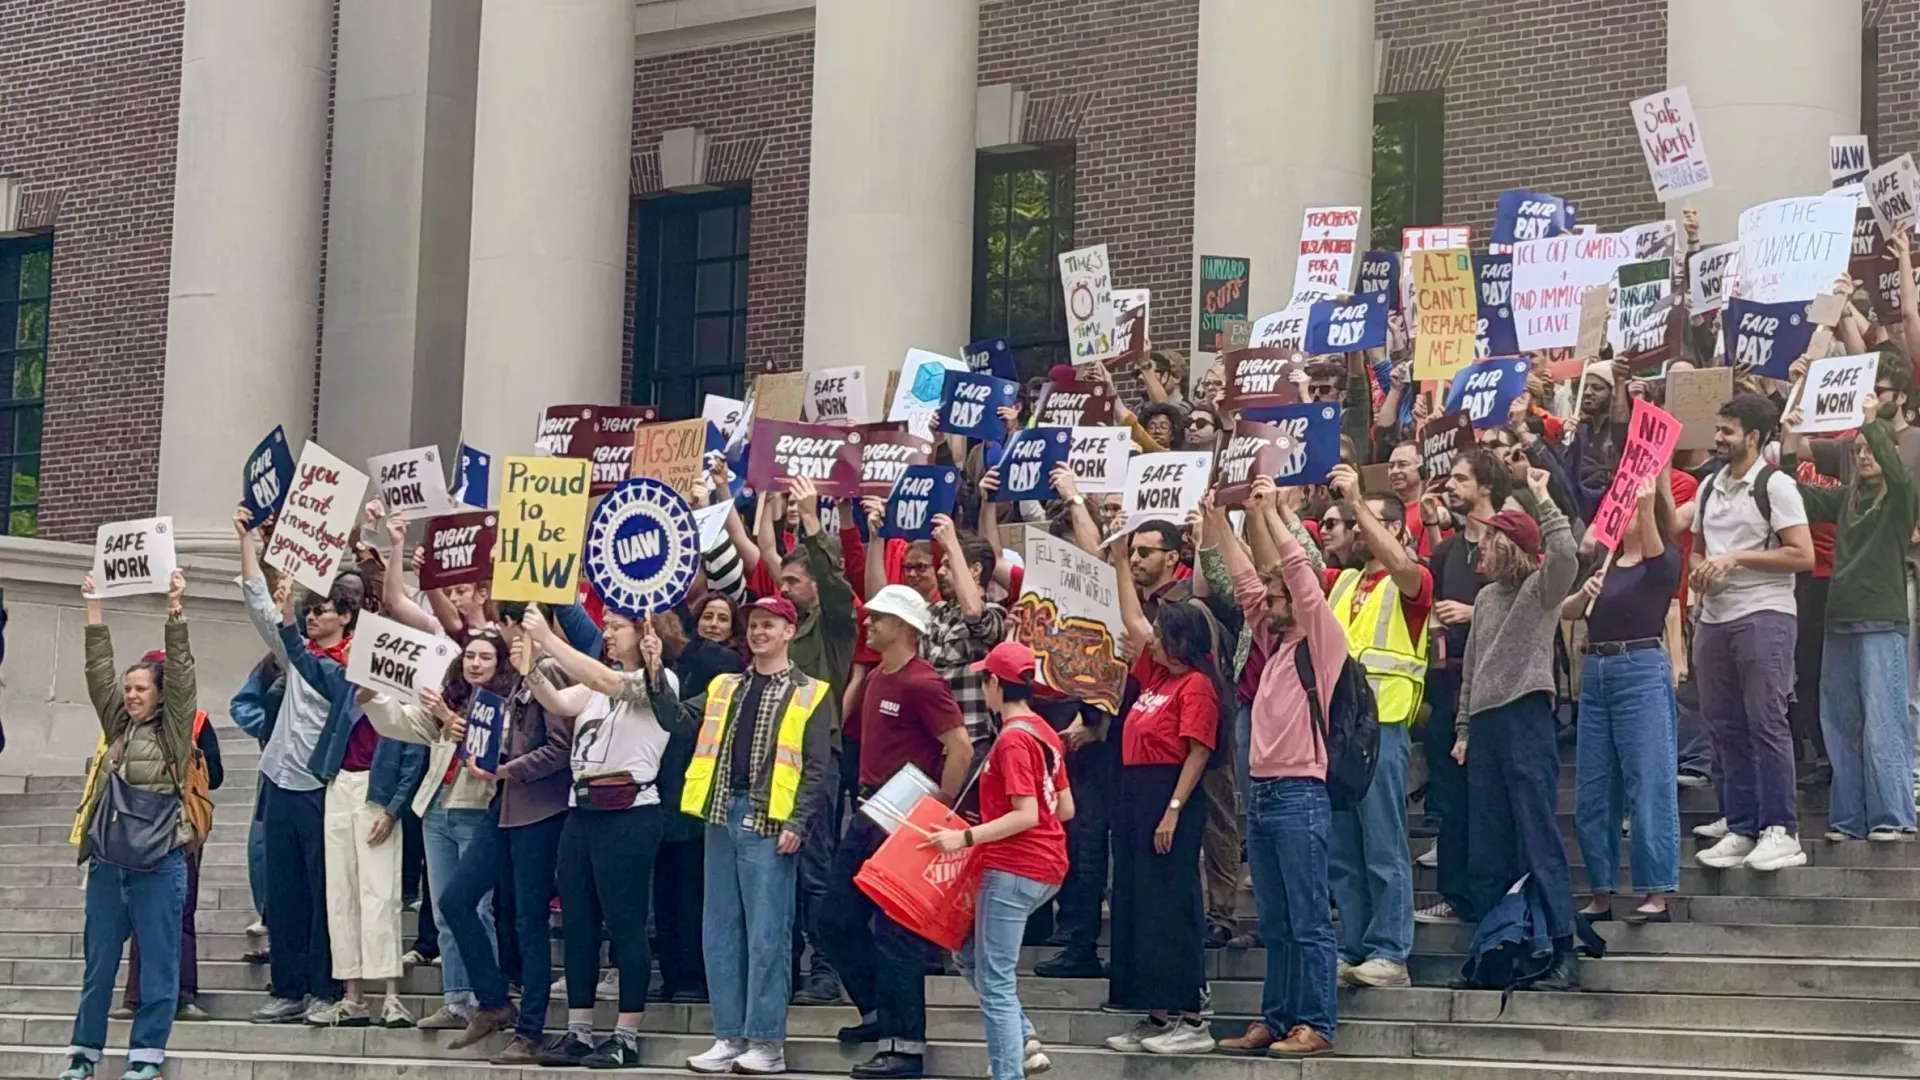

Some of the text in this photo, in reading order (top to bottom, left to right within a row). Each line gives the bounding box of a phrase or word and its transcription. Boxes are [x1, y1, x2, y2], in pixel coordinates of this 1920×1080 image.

[1643, 97, 1681, 133] Safe
[1645, 121, 1696, 166] Work!
[1831, 145, 1864, 170] UAW
[1518, 200, 1557, 217] FAIR
[1780, 201, 1823, 224] THE
[1405, 228, 1470, 250] ICE
[1513, 218, 1551, 240] PAY
[1636, 231, 1660, 245] AFE
[1853, 235, 1876, 255] TAY
[1308, 259, 1327, 273] FOR
[1362, 261, 1390, 277] FAIR
[1480, 263, 1512, 280] FAIR
[1095, 275, 1107, 288] UP
[1481, 280, 1511, 306] PAY
[1701, 275, 1722, 298] WO
[1203, 277, 1247, 314] CUTS
[1419, 287, 1467, 311] CAN'T
[1541, 284, 1592, 310] IMMIG
[1330, 303, 1368, 322] FAIR
[1261, 318, 1304, 338] SAFE
[1327, 321, 1366, 347] PAY
[1421, 314, 1476, 336] REPLACE
[1528, 313, 1571, 336] LEAVE
[1739, 313, 1780, 336] FAIR
[1638, 324, 1668, 352] STAY
[1428, 339, 1462, 368] ME!
[1735, 334, 1775, 367] PAY
[1236, 358, 1288, 376] RIGHT
[1819, 366, 1863, 389] SAFE
[814, 377, 847, 396] SAFE
[1241, 374, 1281, 393] STAY
[1464, 369, 1504, 391] FAIR
[955, 382, 992, 403] FAIR
[1046, 392, 1092, 409] RIGHT
[1815, 390, 1857, 416] WORK
[815, 396, 848, 417] WORK
[949, 401, 986, 428] PAY
[1051, 409, 1085, 426] STAY
[1461, 391, 1497, 422] PAY
[543, 417, 579, 434] IGHT
[1639, 411, 1668, 450] NO
[549, 434, 573, 454] TAY
[593, 446, 635, 462] IGHT
[775, 435, 845, 457] RIGHT
[1012, 439, 1046, 459] FAIR
[250, 447, 273, 481] FAIR
[381, 460, 418, 484] SAFE
[774, 455, 837, 480] TO STAY
[862, 461, 908, 481] STAY
[1069, 457, 1106, 479] ORK
[1139, 463, 1188, 484] SAFE
[1227, 457, 1256, 484] STAY
[251, 467, 281, 509] PAY
[299, 463, 340, 491] you
[508, 462, 586, 496] Proud
[899, 476, 934, 497] FAIR
[1008, 461, 1040, 492] PAY
[518, 499, 543, 521] to
[1136, 487, 1182, 511] WORK
[820, 506, 840, 537] PA
[896, 499, 927, 530] PAY
[433, 525, 482, 548] RIGHT
[538, 520, 566, 542] be
[103, 531, 148, 555] SAFE
[616, 529, 660, 565] UAW
[270, 533, 333, 577] yourself
[441, 545, 477, 569] STAY
[498, 528, 577, 589] HAW
[103, 554, 151, 581] WORK
[374, 633, 427, 662] SAFE
[370, 652, 418, 689] WORK
[471, 701, 496, 726] FAIR
[466, 725, 491, 758] PAY
